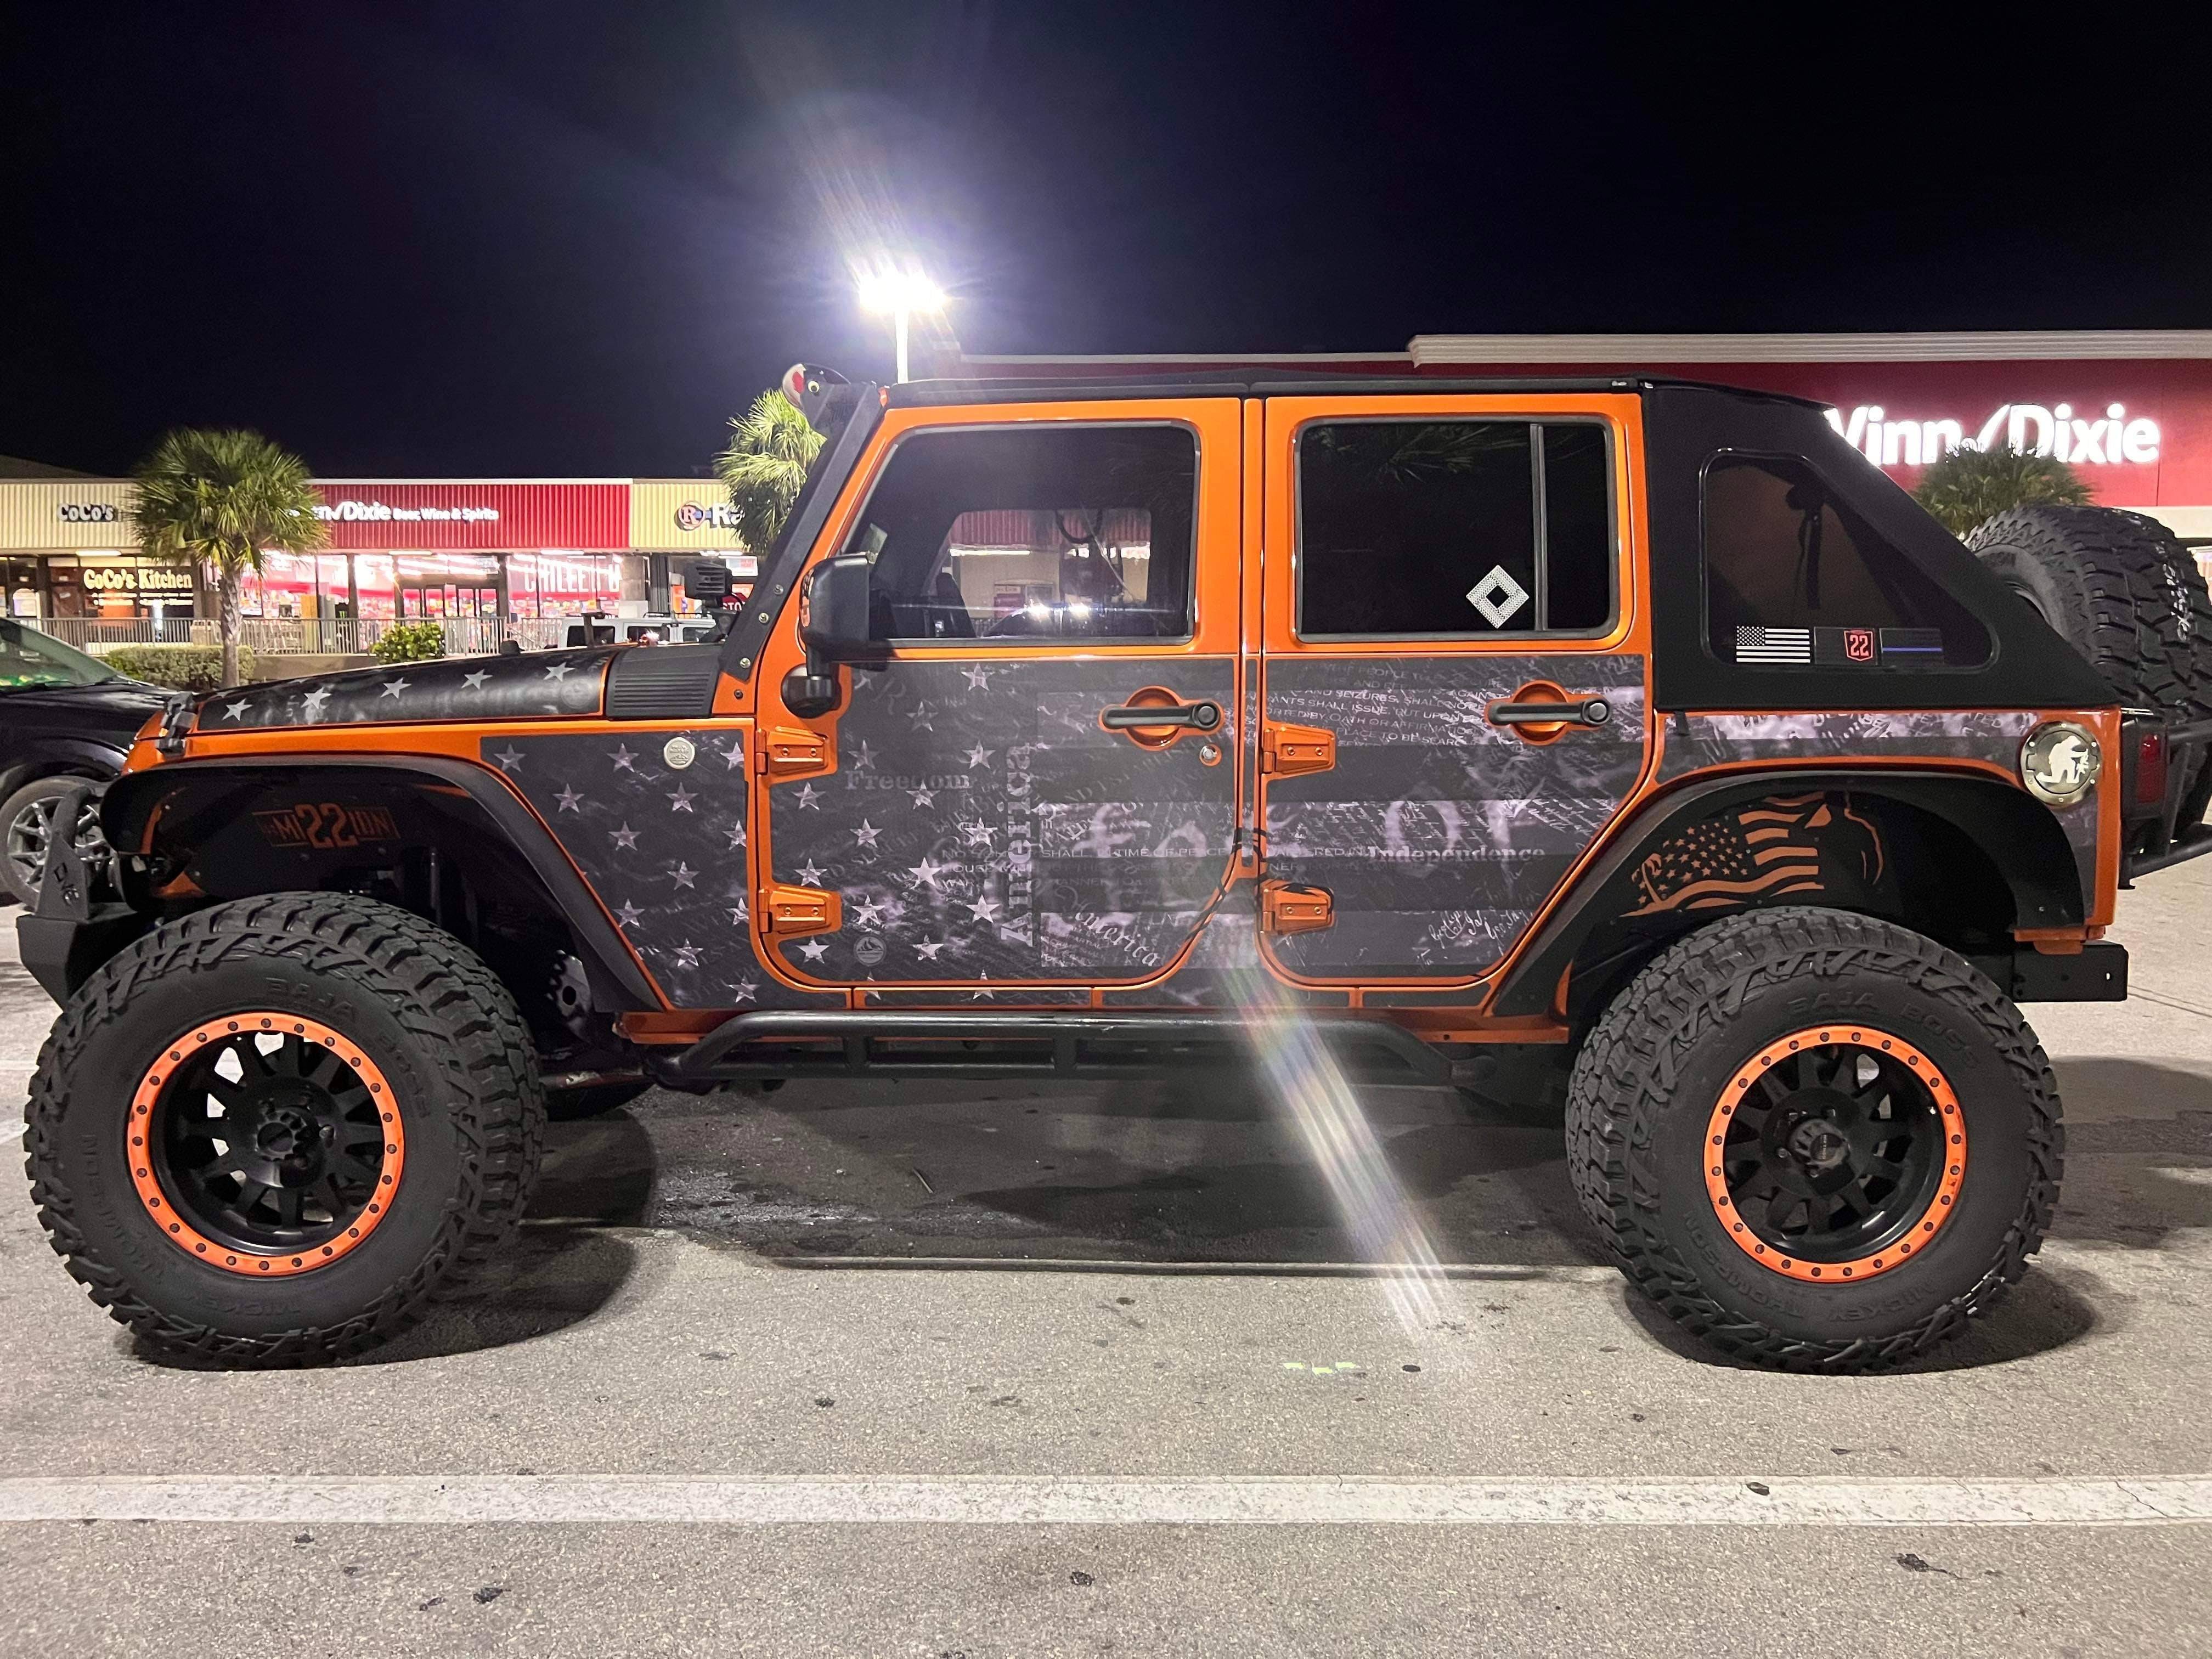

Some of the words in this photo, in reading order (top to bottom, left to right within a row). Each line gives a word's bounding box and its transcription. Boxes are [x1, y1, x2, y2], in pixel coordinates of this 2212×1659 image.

[57, 503, 114, 521] CoCo's
[84, 568, 137, 589] CoCo's
[138, 568, 193, 589] Kitchen
[1849, 634, 1870, 657] 22
[1001, 742, 1033, 947] America
[1368, 845, 1545, 864] Independence
